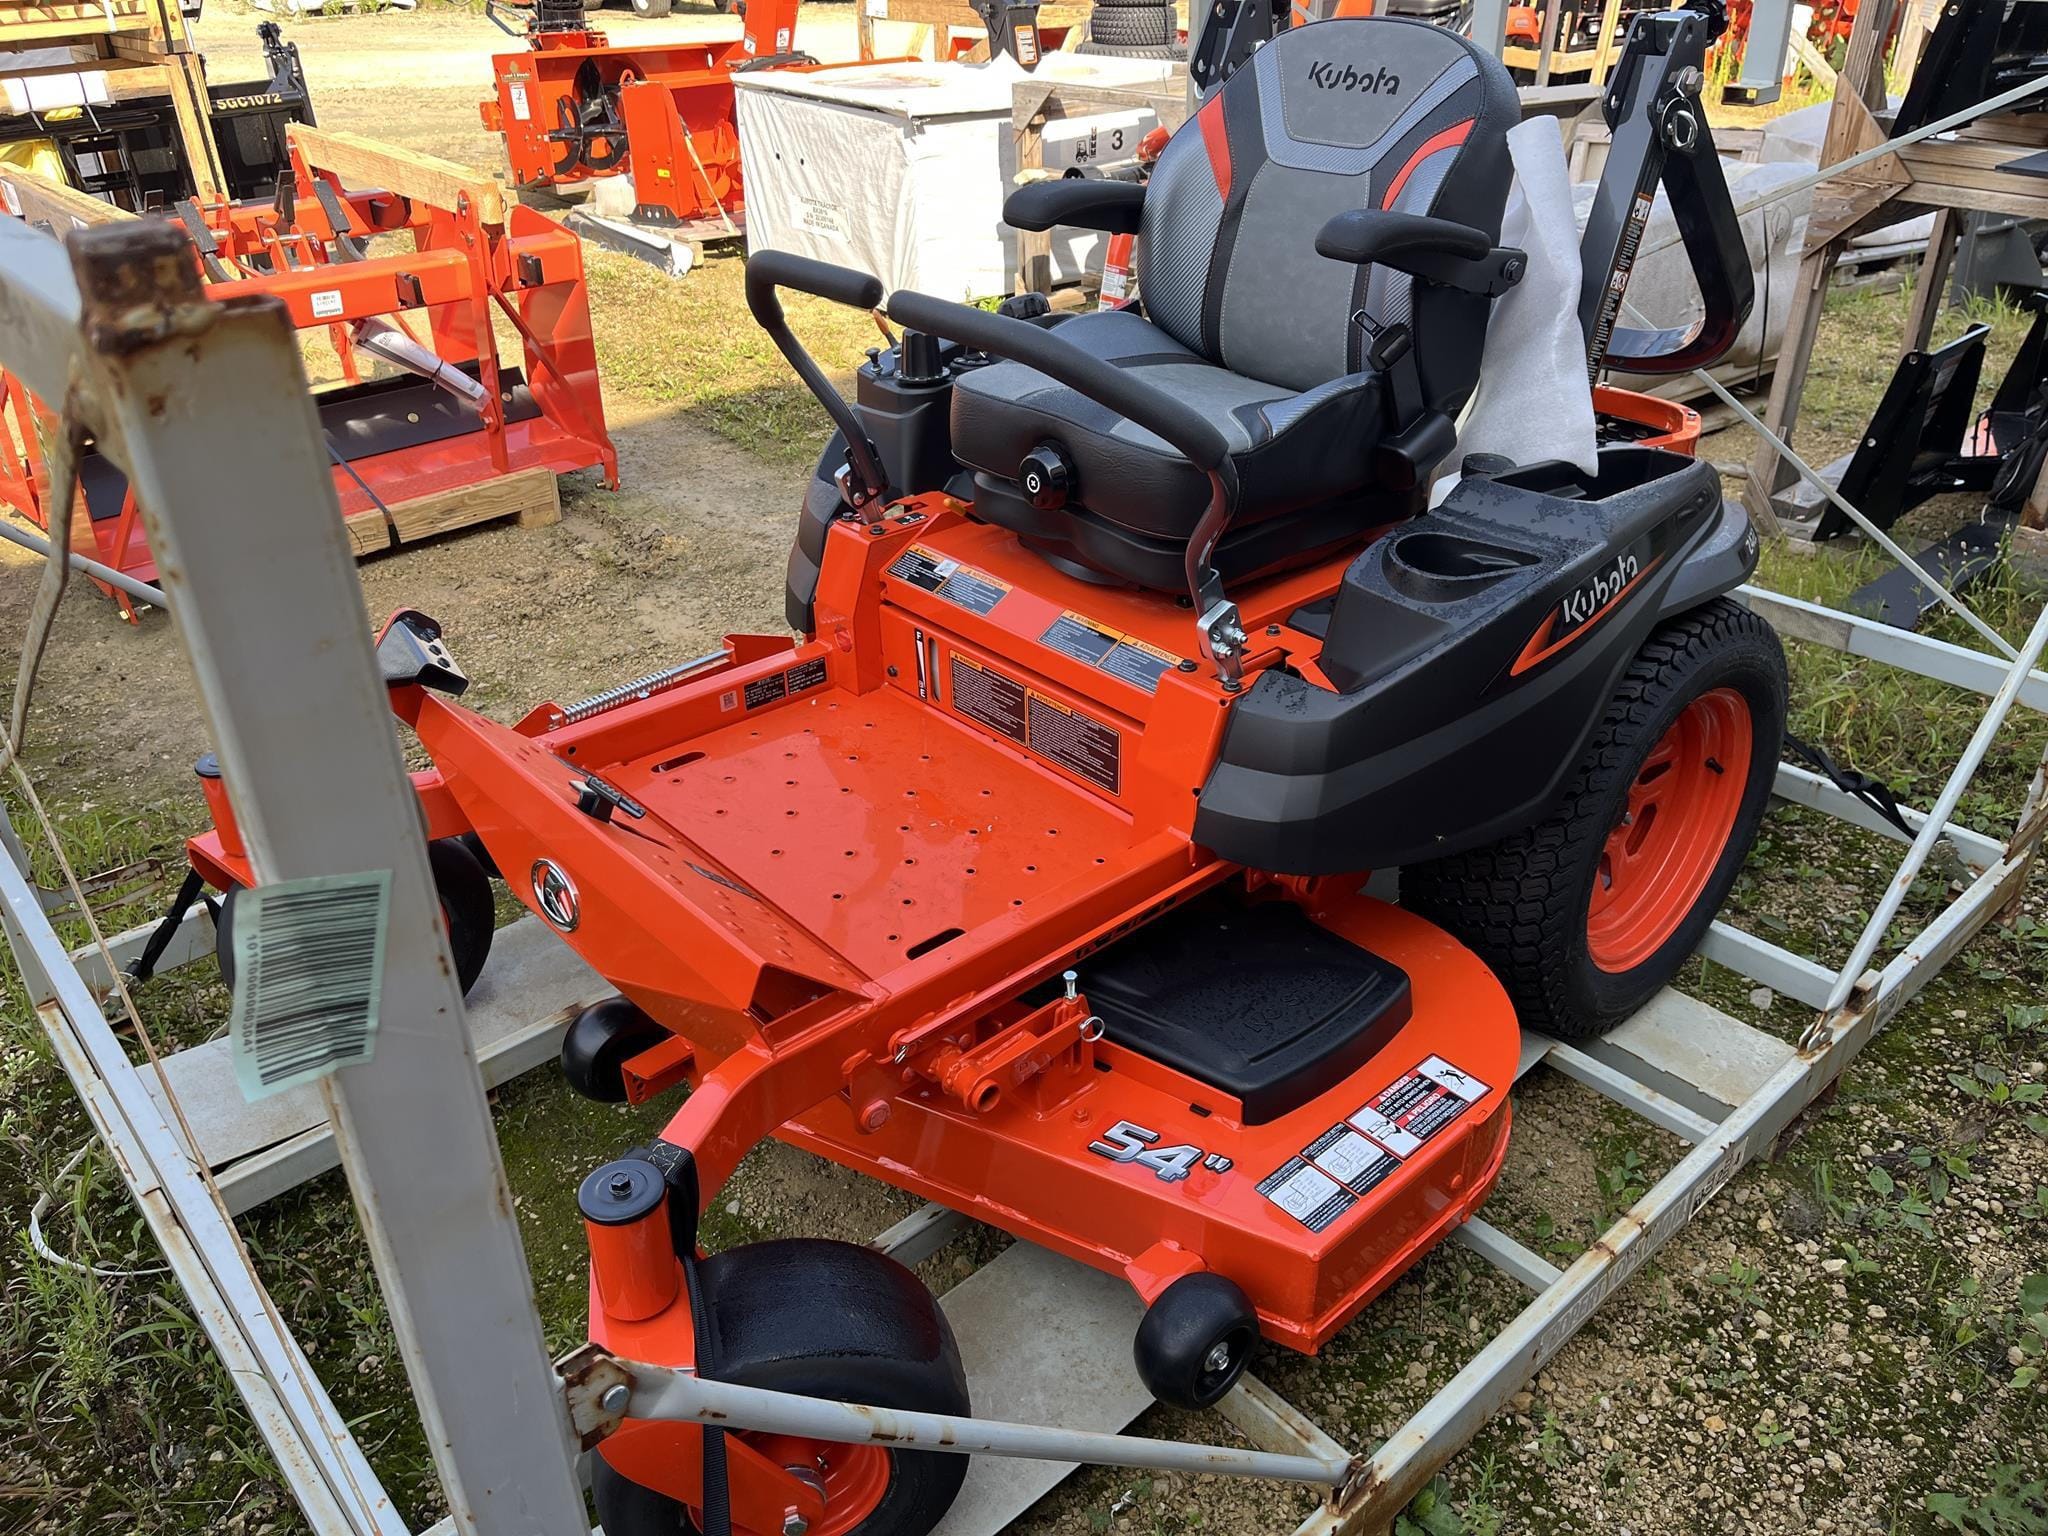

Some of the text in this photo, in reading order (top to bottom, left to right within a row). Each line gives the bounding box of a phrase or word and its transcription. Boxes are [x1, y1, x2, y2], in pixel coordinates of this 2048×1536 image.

[1308, 61, 1400, 95] Kubota
[216, 93, 282, 110] SGC1072
[1112, 129, 1123, 150] 3
[1562, 554, 1638, 623] Kubota
[1076, 615, 1100, 629] WARNING
[916, 631, 922, 640] F
[1139, 641, 1178, 663] ADVERTENCIA
[920, 688, 926, 698] E
[1375, 1104, 1386, 1112] DO
[1381, 1097, 1394, 1107] NOT
[1389, 1091, 1402, 1100] PUT
[1397, 1081, 1415, 1095] HANDS
[1382, 1078, 1431, 1116] FEET INTO MOWER WHEN
[1384, 1075, 1411, 1099] DANGER
[1388, 1106, 1407, 1120] ENGINE
[1412, 1093, 1441, 1117] PELIGRO
